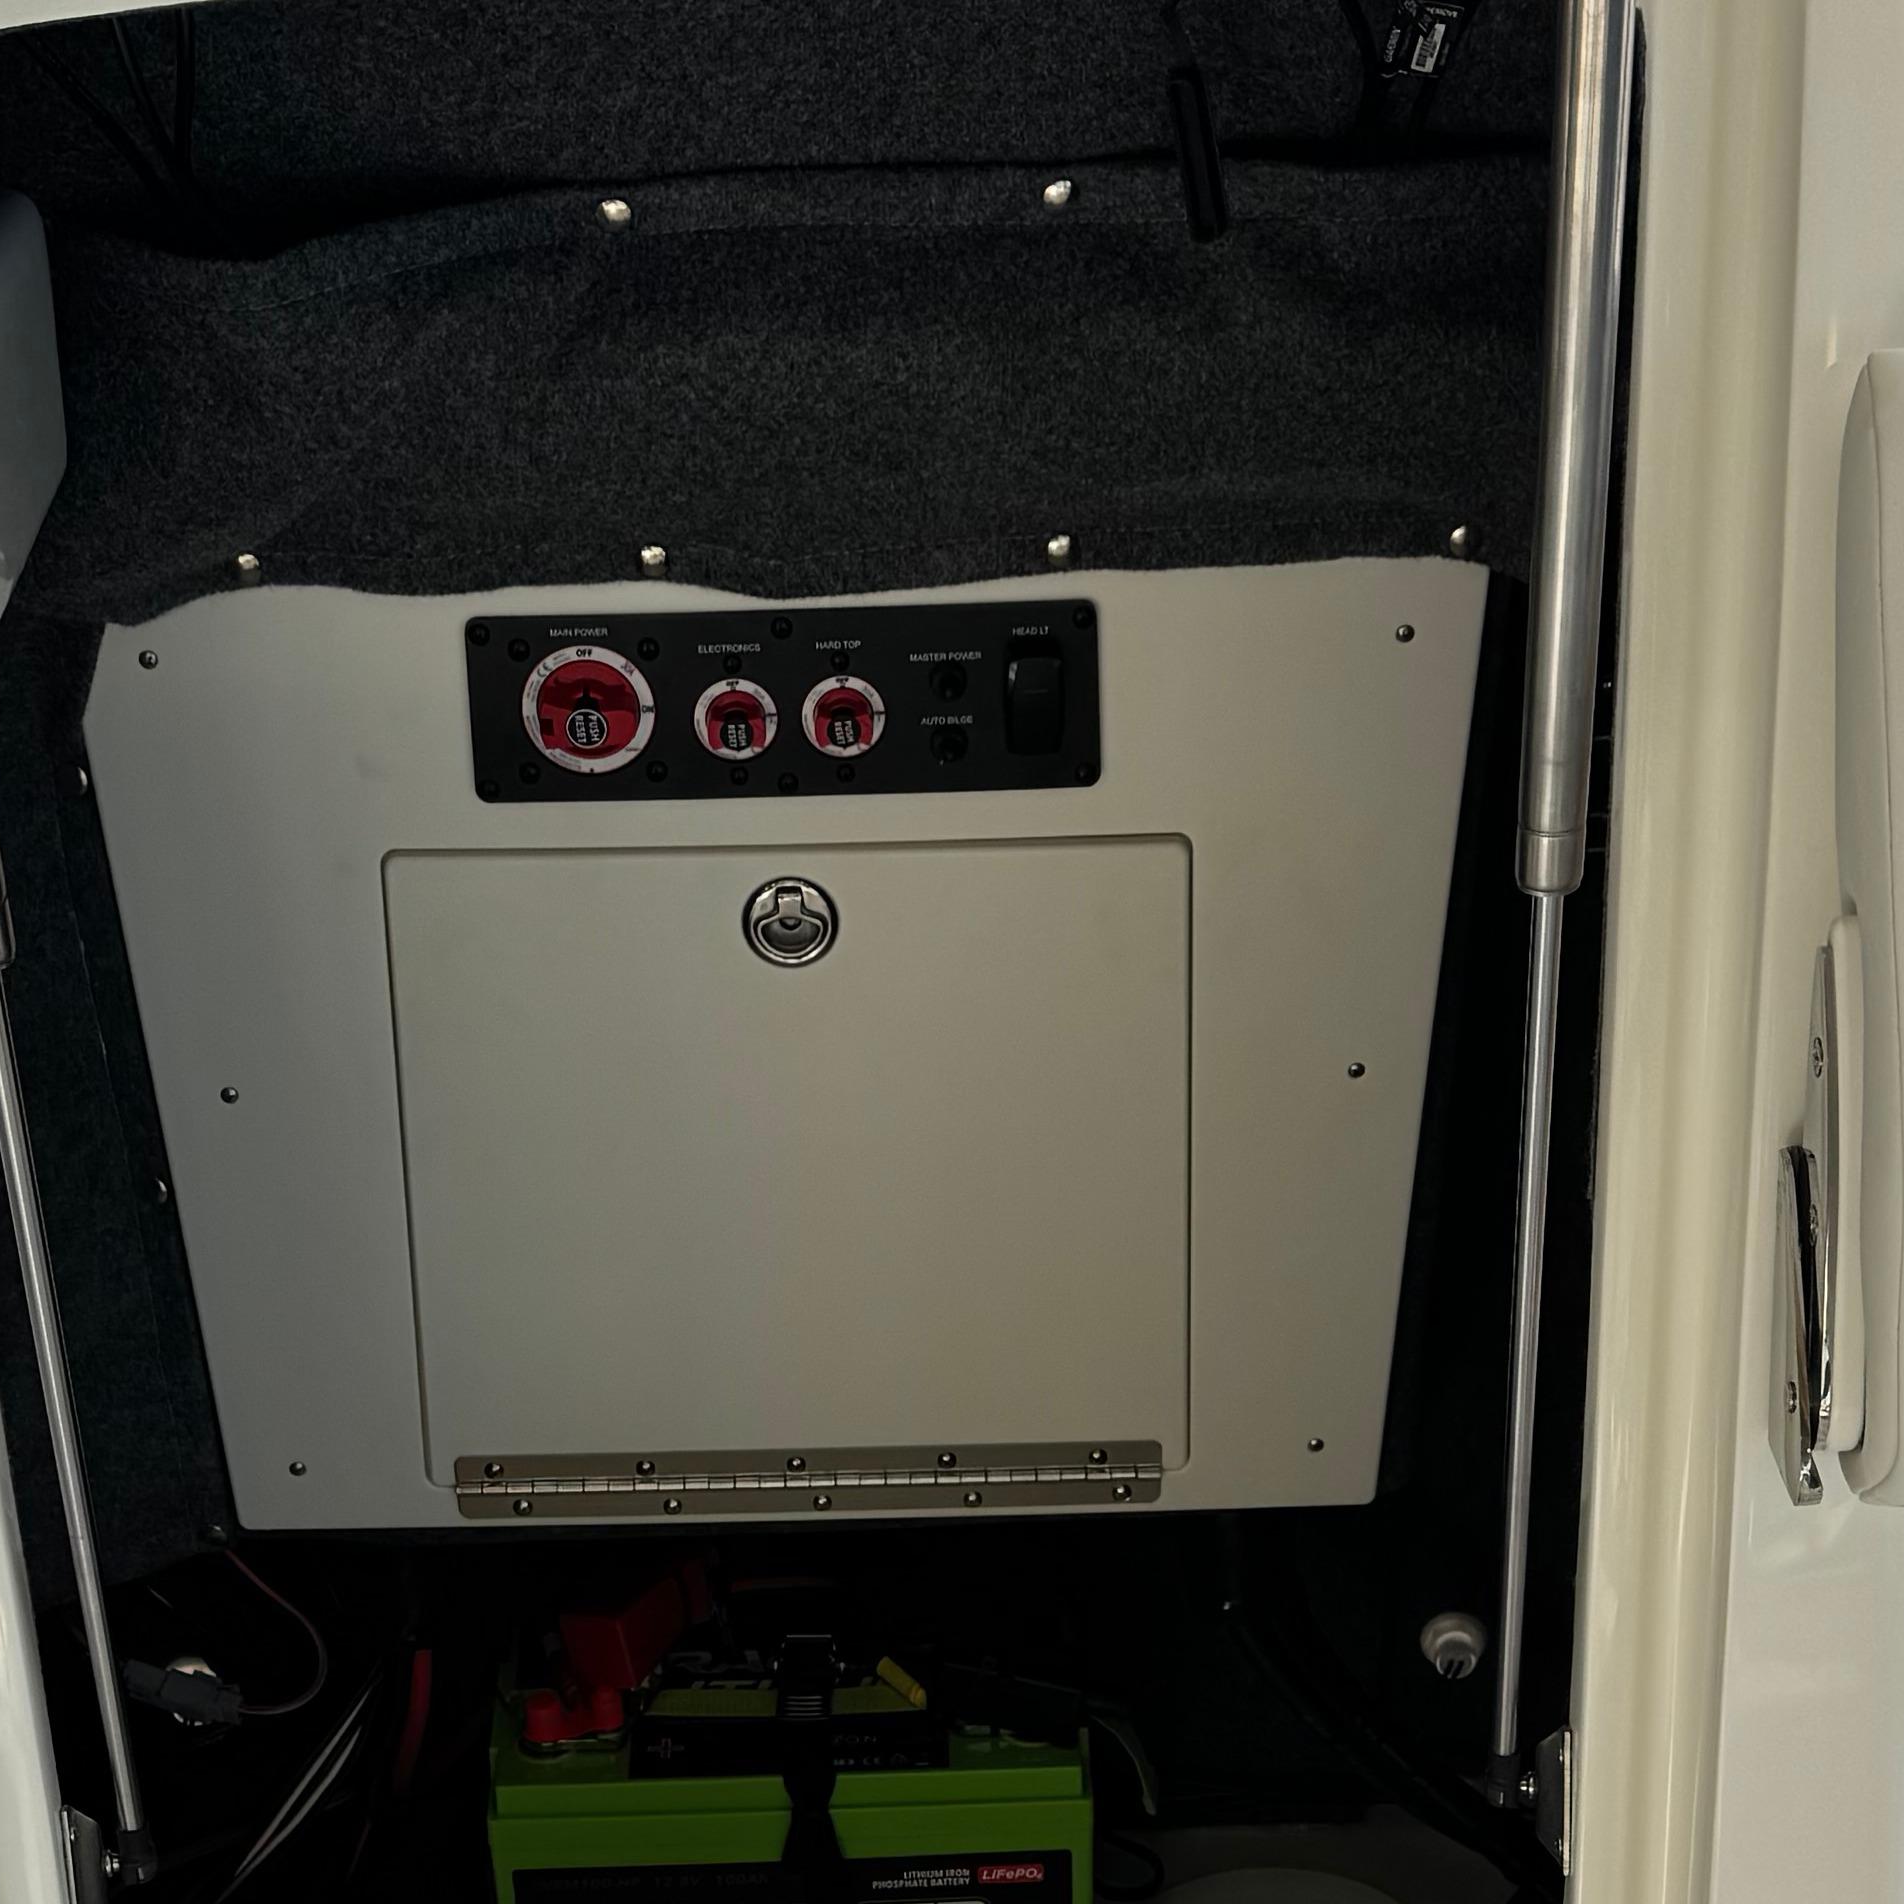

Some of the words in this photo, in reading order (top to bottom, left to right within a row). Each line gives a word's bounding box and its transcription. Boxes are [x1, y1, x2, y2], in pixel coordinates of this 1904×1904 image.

[549, 627, 573, 638] MAIN
[574, 626, 609, 637] POWER
[1011, 626, 1039, 636] HEAD
[697, 643, 761, 655] ELECTRONICS
[815, 641, 841, 651] HARD
[842, 640, 861, 650] TOP
[575, 648, 593, 657] OFF
[909, 652, 947, 662] MASTER
[948, 651, 982, 661] POWER
[920, 716, 946, 726] AUTO
[945, 1868, 971, 1878] IRON
[872, 1877, 929, 1890] PHOSPHATE
[930, 1877, 971, 1888] BATTERY
